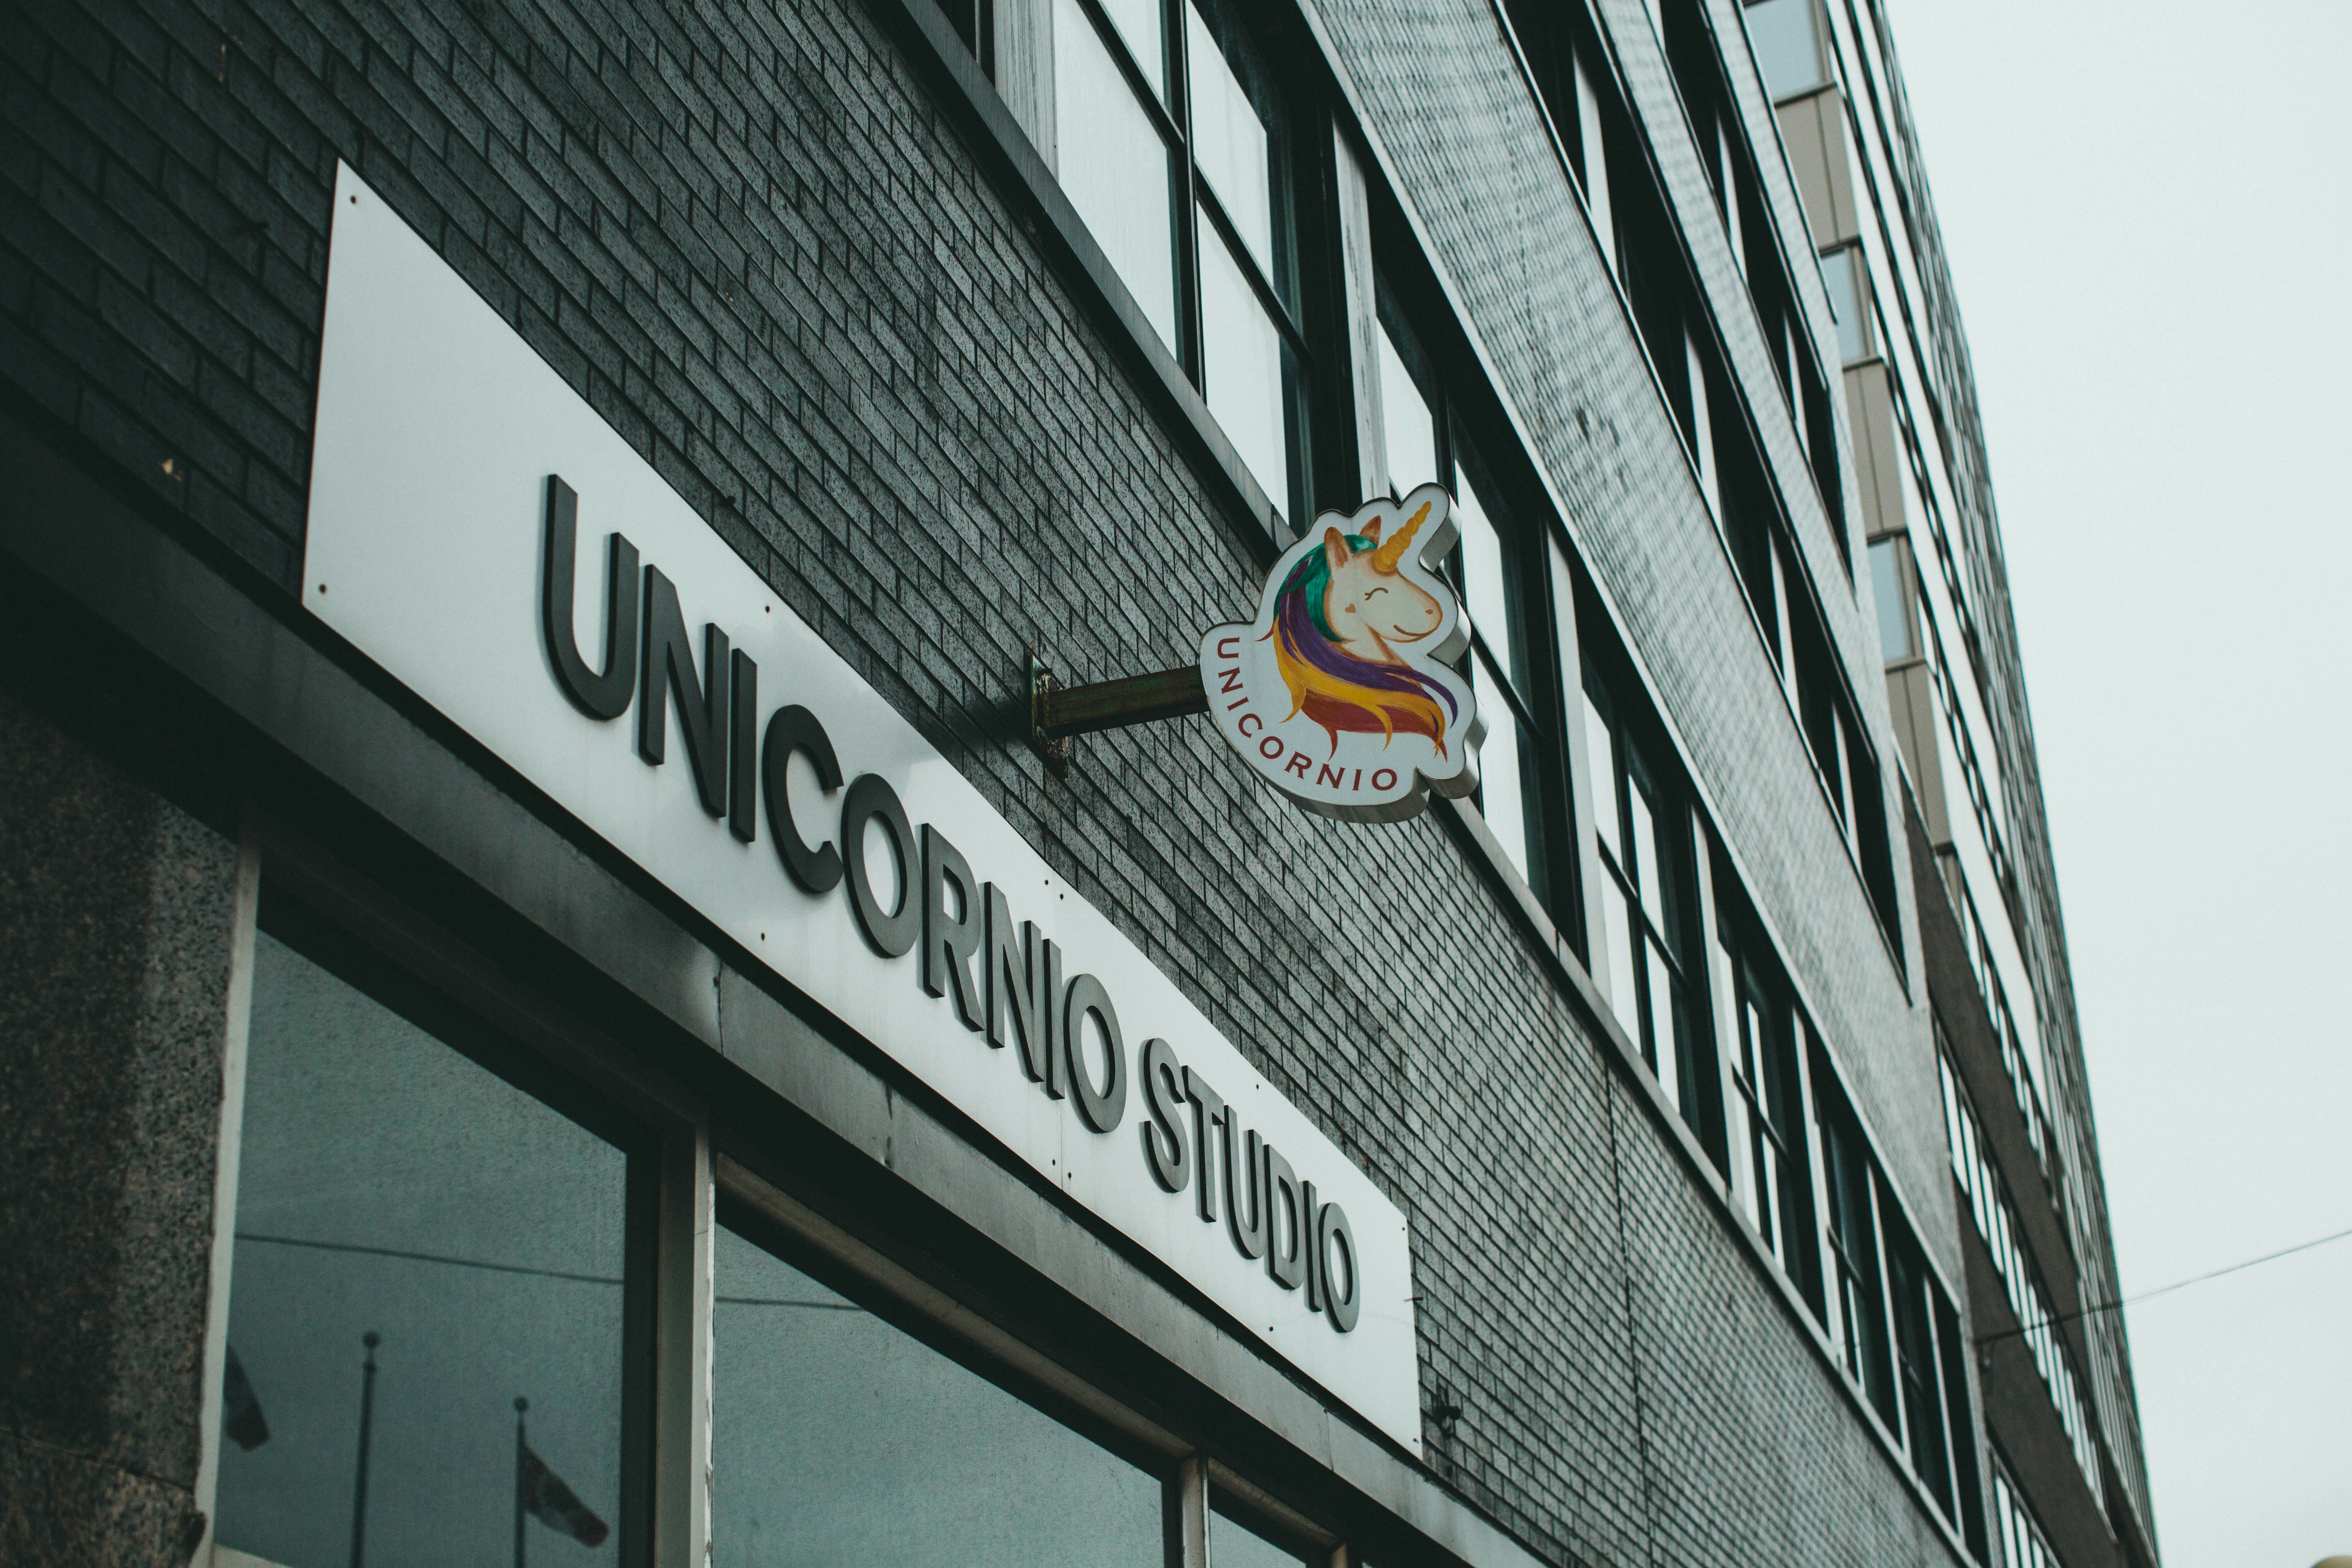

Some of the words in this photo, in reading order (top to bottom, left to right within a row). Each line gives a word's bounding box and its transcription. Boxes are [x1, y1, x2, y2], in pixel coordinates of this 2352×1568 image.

[543, 474, 1127, 1133] UNICORNIO
[1144, 1038, 1360, 1333] STUDIO
[1217, 637, 1397, 791] UNICORNIO
